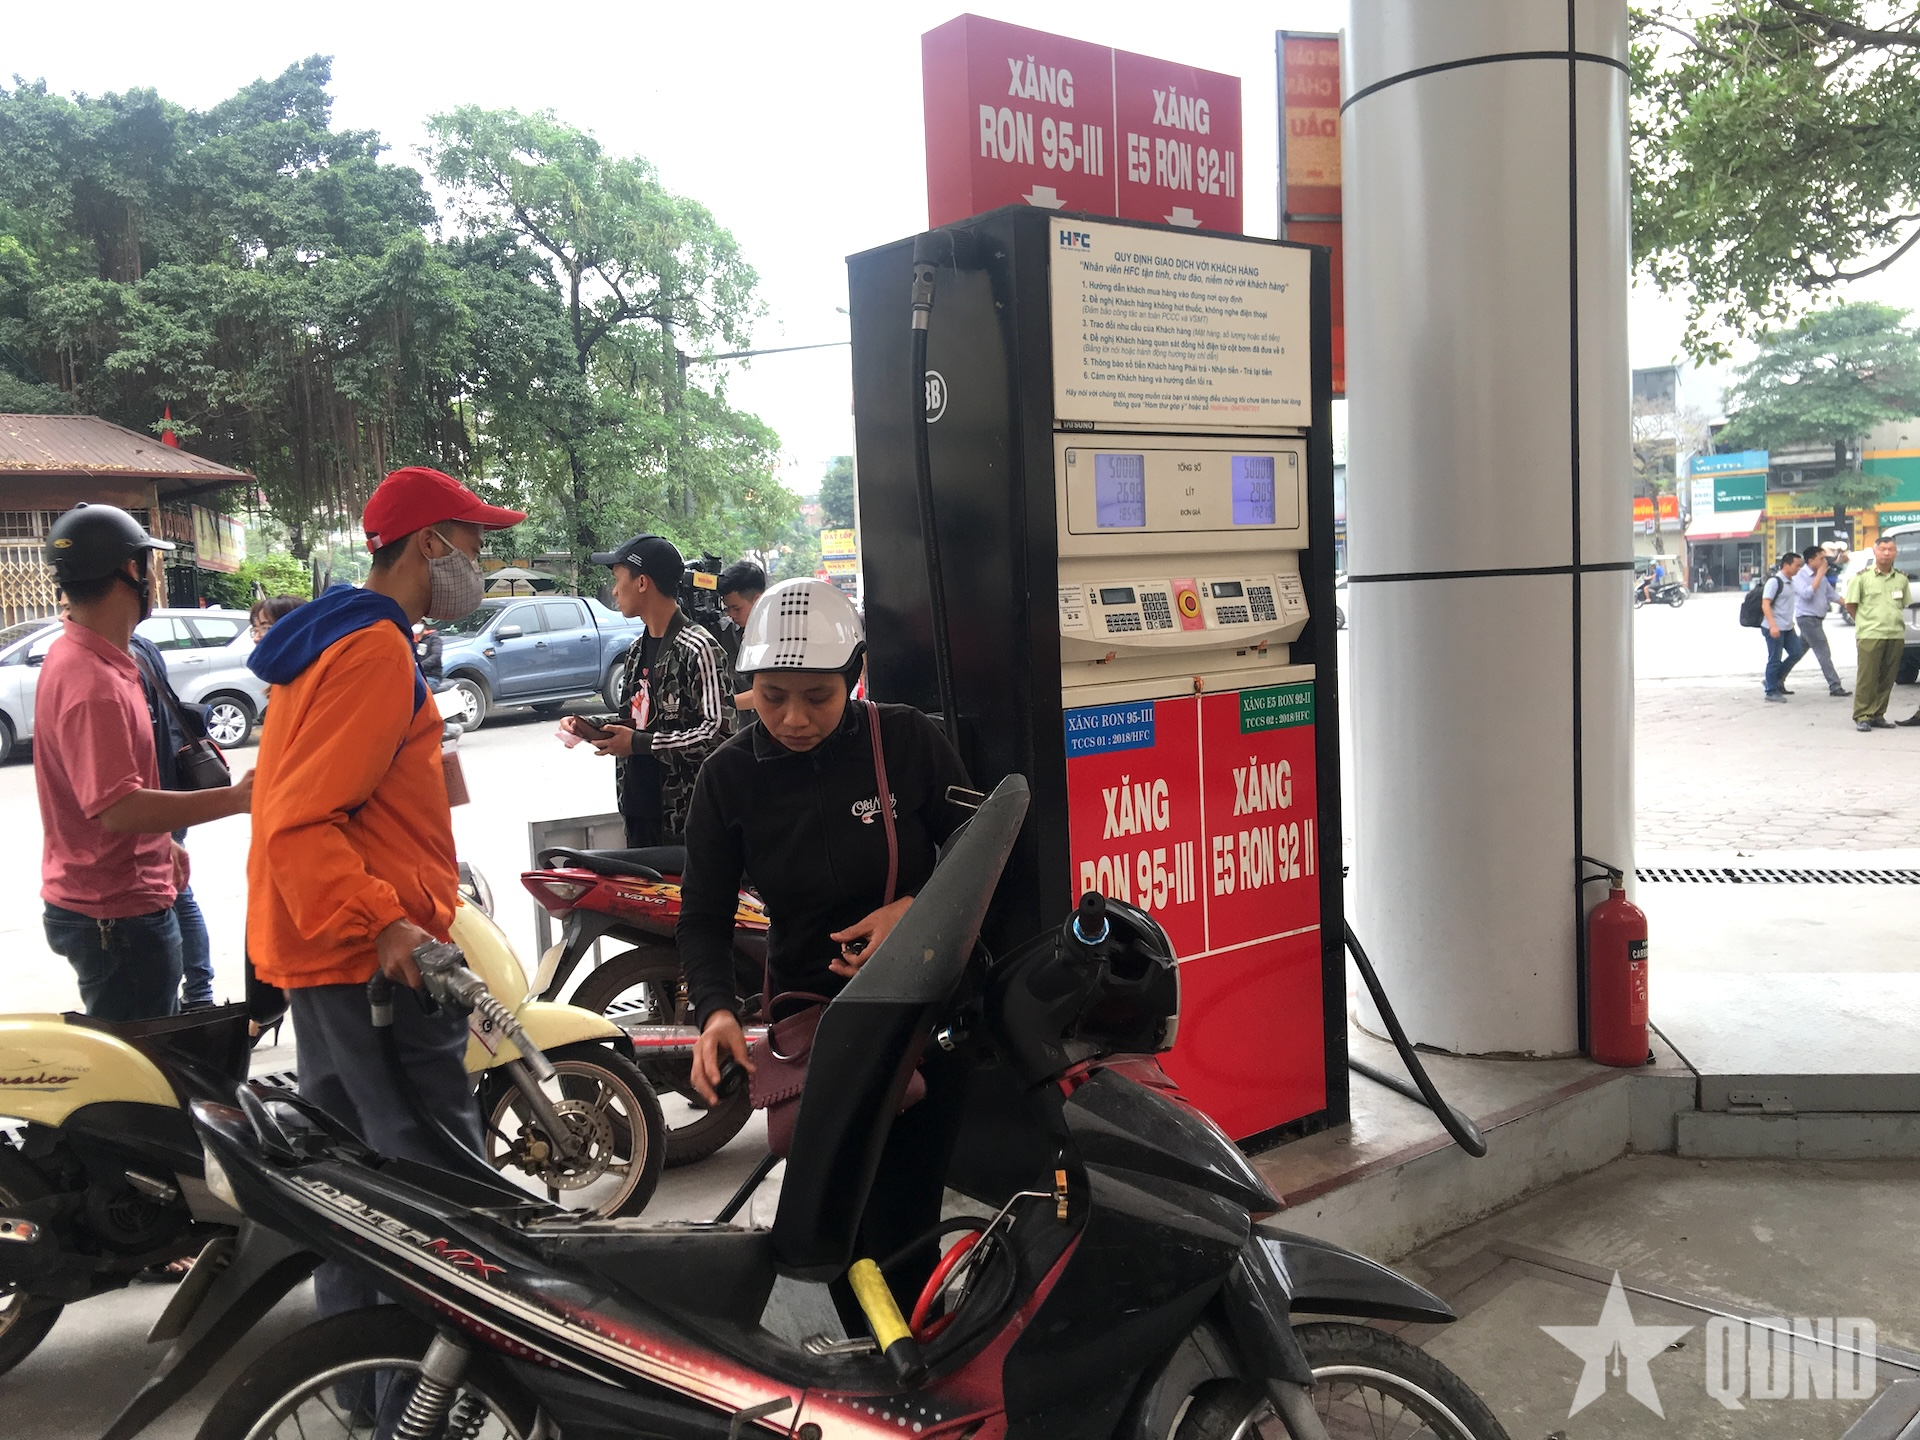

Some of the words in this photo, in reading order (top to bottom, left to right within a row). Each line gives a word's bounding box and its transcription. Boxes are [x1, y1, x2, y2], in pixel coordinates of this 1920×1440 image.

[1008, 54, 1074, 108] XĂNG
[1152, 85, 1210, 134] XĂNG
[979, 104, 1034, 165] RON
[1042, 117, 1104, 176] 95-III
[1128, 132, 1150, 184] E5
[1155, 138, 1192, 191] RON
[1196, 145, 1235, 198] 92-II
[1060, 230, 1090, 248] HFC
[1114, 252, 1132, 262] QUY
[1134, 254, 1152, 265] ĐỊNH
[1155, 257, 1174, 267] GIAO
[1176, 259, 1194, 270] DỊCH
[1196, 260, 1209, 271] VỚI
[1211, 262, 1236, 274] KHÁCH
[1239, 265, 1259, 276] HÀNG
[1106, 264, 1121, 274] viên
[1124, 266, 1140, 276] HFC
[1142, 268, 1153, 279] tận
[1173, 272, 1187, 280] chu
[1205, 275, 1222, 284] niềm
[1224, 277, 1233, 286] nở
[1236, 278, 1246, 287] với
[1248, 279, 1267, 289] khách
[1089, 281, 1112, 292] Hướng
[1113, 283, 1125, 292] dẫn
[1127, 284, 1145, 294] khách
[1162, 288, 1177, 299] hàng
[1179, 290, 1189, 298] vào
[1191, 291, 1205, 301] đúng
[1218, 296, 1228, 304] quy
[1230, 296, 1243, 304] định
[1090, 294, 1098, 303] Đề
[1100, 296, 1114, 306] nghị
[1116, 298, 1135, 307] Khách
[1137, 300, 1152, 310] hàng
[1154, 301, 1172, 312] không
[1205, 306, 1223, 316] không
[1225, 309, 1239, 317] nghe
[1240, 309, 1252, 318] điện
[1254, 310, 1267, 320] thoại
[1090, 320, 1104, 328] Trao
[1131, 322, 1141, 332] cầu
[1143, 324, 1154, 332] của
[1156, 324, 1175, 334] Khách
[1177, 327, 1191, 337] hàng
[1090, 333, 1098, 342] Đề
[1100, 336, 1114, 345] nghị
[1116, 336, 1136, 344] Khách
[1137, 338, 1152, 348] hàng
[1181, 340, 1196, 350] đồng
[1197, 341, 1205, 349] hồ
[1206, 342, 1218, 351] điện
[1238, 344, 1251, 353] bơm
[1091, 358, 1110, 368] Thông
[1112, 359, 1124, 368] báo
[1126, 360, 1133, 368] số
[1134, 360, 1146, 369] tiền
[1148, 362, 1167, 370] Khách
[1168, 362, 1183, 372] hàng
[1184, 364, 1197, 372] Phải
[1212, 365, 1226, 375] Nhận
[1228, 365, 1238, 374] tiền
[1244, 367, 1252, 375] Trả
[1262, 367, 1272, 376] tiền
[1091, 372, 1105, 380] Cảm
[1117, 374, 1136, 382] Khách
[1138, 375, 1153, 384] hàng
[1164, 376, 1183, 386] hướng
[1244, 696, 1265, 712] XĂNG
[1267, 696, 1276, 708] E5
[1278, 694, 1294, 707] RON
[1294, 692, 1310, 704] 92-II
[1068, 714, 1099, 731] XĂNG
[1102, 712, 1124, 727] RON
[1127, 708, 1153, 724] 95-III
[1245, 716, 1265, 728] TCCS
[1266, 716, 1274, 725] 02
[1072, 736, 1096, 750] TCCS
[1097, 736, 1106, 746] 01
[1112, 729, 1150, 744] 2018/HFC
[1233, 755, 1292, 817] XĂNG
[1102, 774, 1170, 840] XĂNG
[1212, 835, 1236, 896] E5
[1239, 826, 1274, 891] RON
[1278, 822, 1300, 883] 92
[1136, 840, 1195, 913] 95-III
